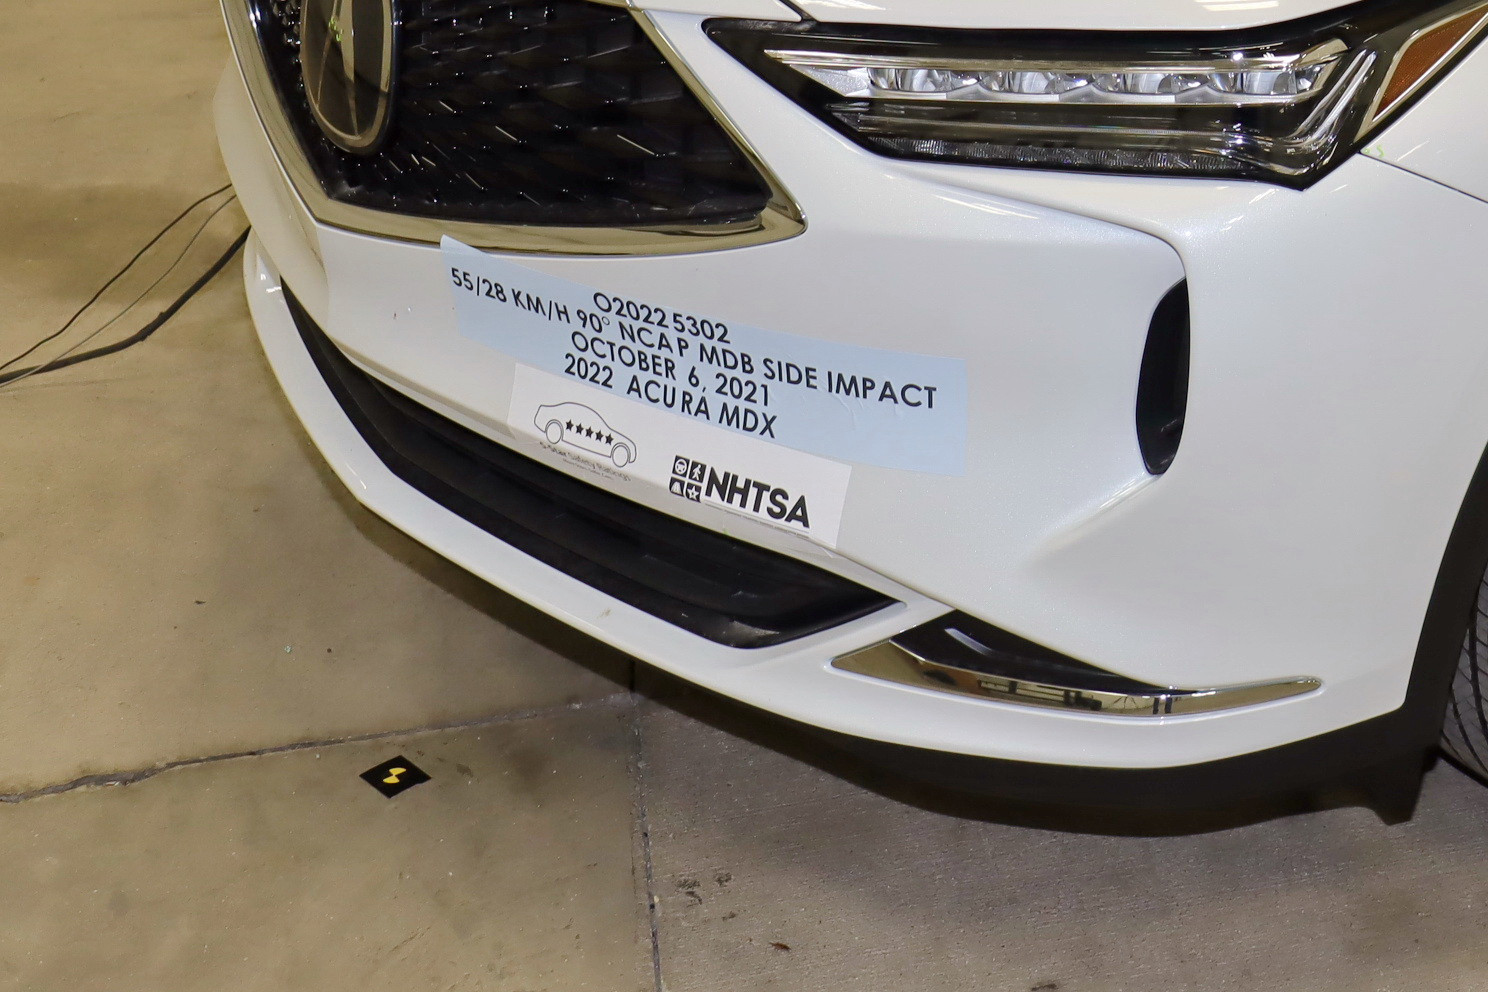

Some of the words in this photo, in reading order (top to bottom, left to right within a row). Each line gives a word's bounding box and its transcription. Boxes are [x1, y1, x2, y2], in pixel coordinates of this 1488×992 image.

[451, 267, 507, 303] 55/28
[511, 288, 571, 324] KM/H
[618, 321, 689, 357] NCAP
[700, 343, 754, 374] MDB
[763, 358, 818, 390] SIDE
[827, 371, 937, 409] IMPACT
[571, 331, 676, 381] OCTOBER
[688, 365, 706, 393] 6,
[715, 372, 768, 407] 2021
[564, 353, 613, 389] 2022
[626, 375, 710, 421] ACURA
[718, 402, 777, 439] MDX
[705, 467, 810, 529] NHTSA
